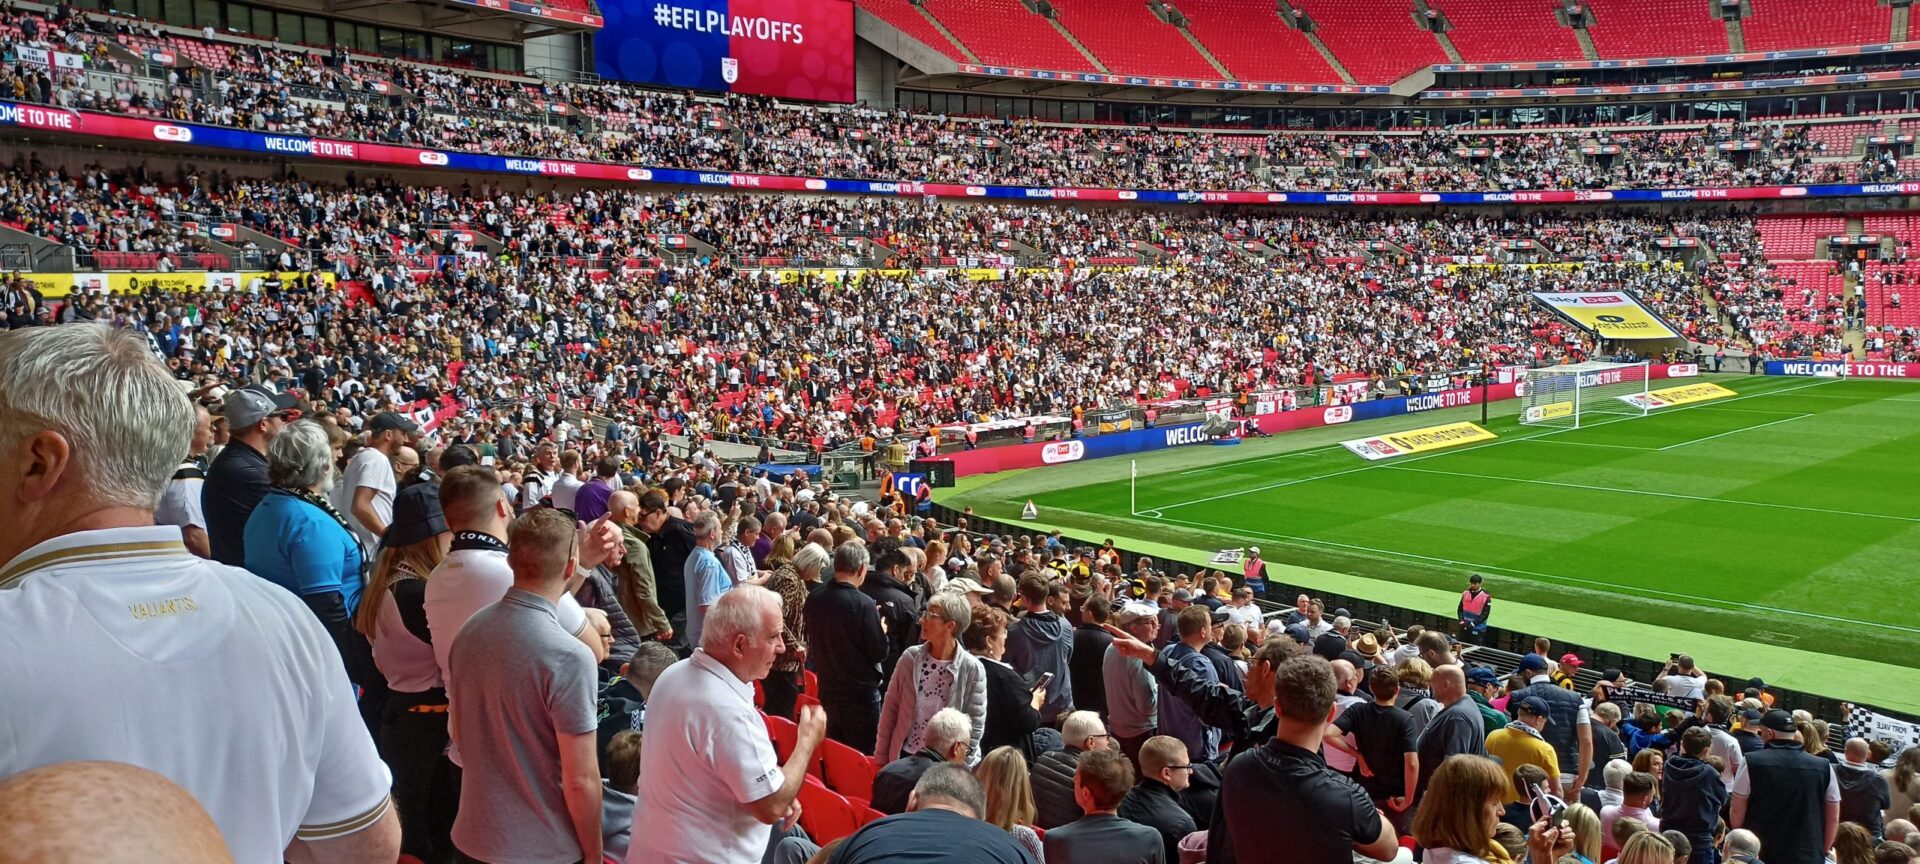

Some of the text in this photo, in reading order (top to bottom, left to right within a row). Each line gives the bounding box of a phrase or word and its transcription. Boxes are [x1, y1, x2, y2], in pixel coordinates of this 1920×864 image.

[654, 3, 803, 44] #EFLPLAYOFFS
[28, 109, 45, 126] TO
[49, 112, 72, 129] THE
[265, 137, 353, 157] WELCOME TO THE
[505, 159, 576, 175] WELCOME TO THE
[699, 173, 760, 186] WELCOME TO THE
[869, 183, 901, 193] WELCOME
[902, 185, 911, 193] TO
[1026, 188, 1078, 198] WELCOME TO THE
[1661, 190, 1699, 198] WELCOME
[1712, 189, 1727, 197] THE
[1861, 184, 1919, 193] WELCOME TO
[1326, 194, 1378, 202] WELCOME TO THE
[1483, 193, 1517, 201] WELCOME
[1784, 363, 1905, 376] WELCOME TO THE
[1577, 373, 1603, 387] ELCOME
[1603, 372, 1611, 384] TO
[1406, 391, 1471, 412] WELCOME TO THE
[1046, 445, 1069, 455] sky bet
[128, 596, 196, 620] VALIANTS
